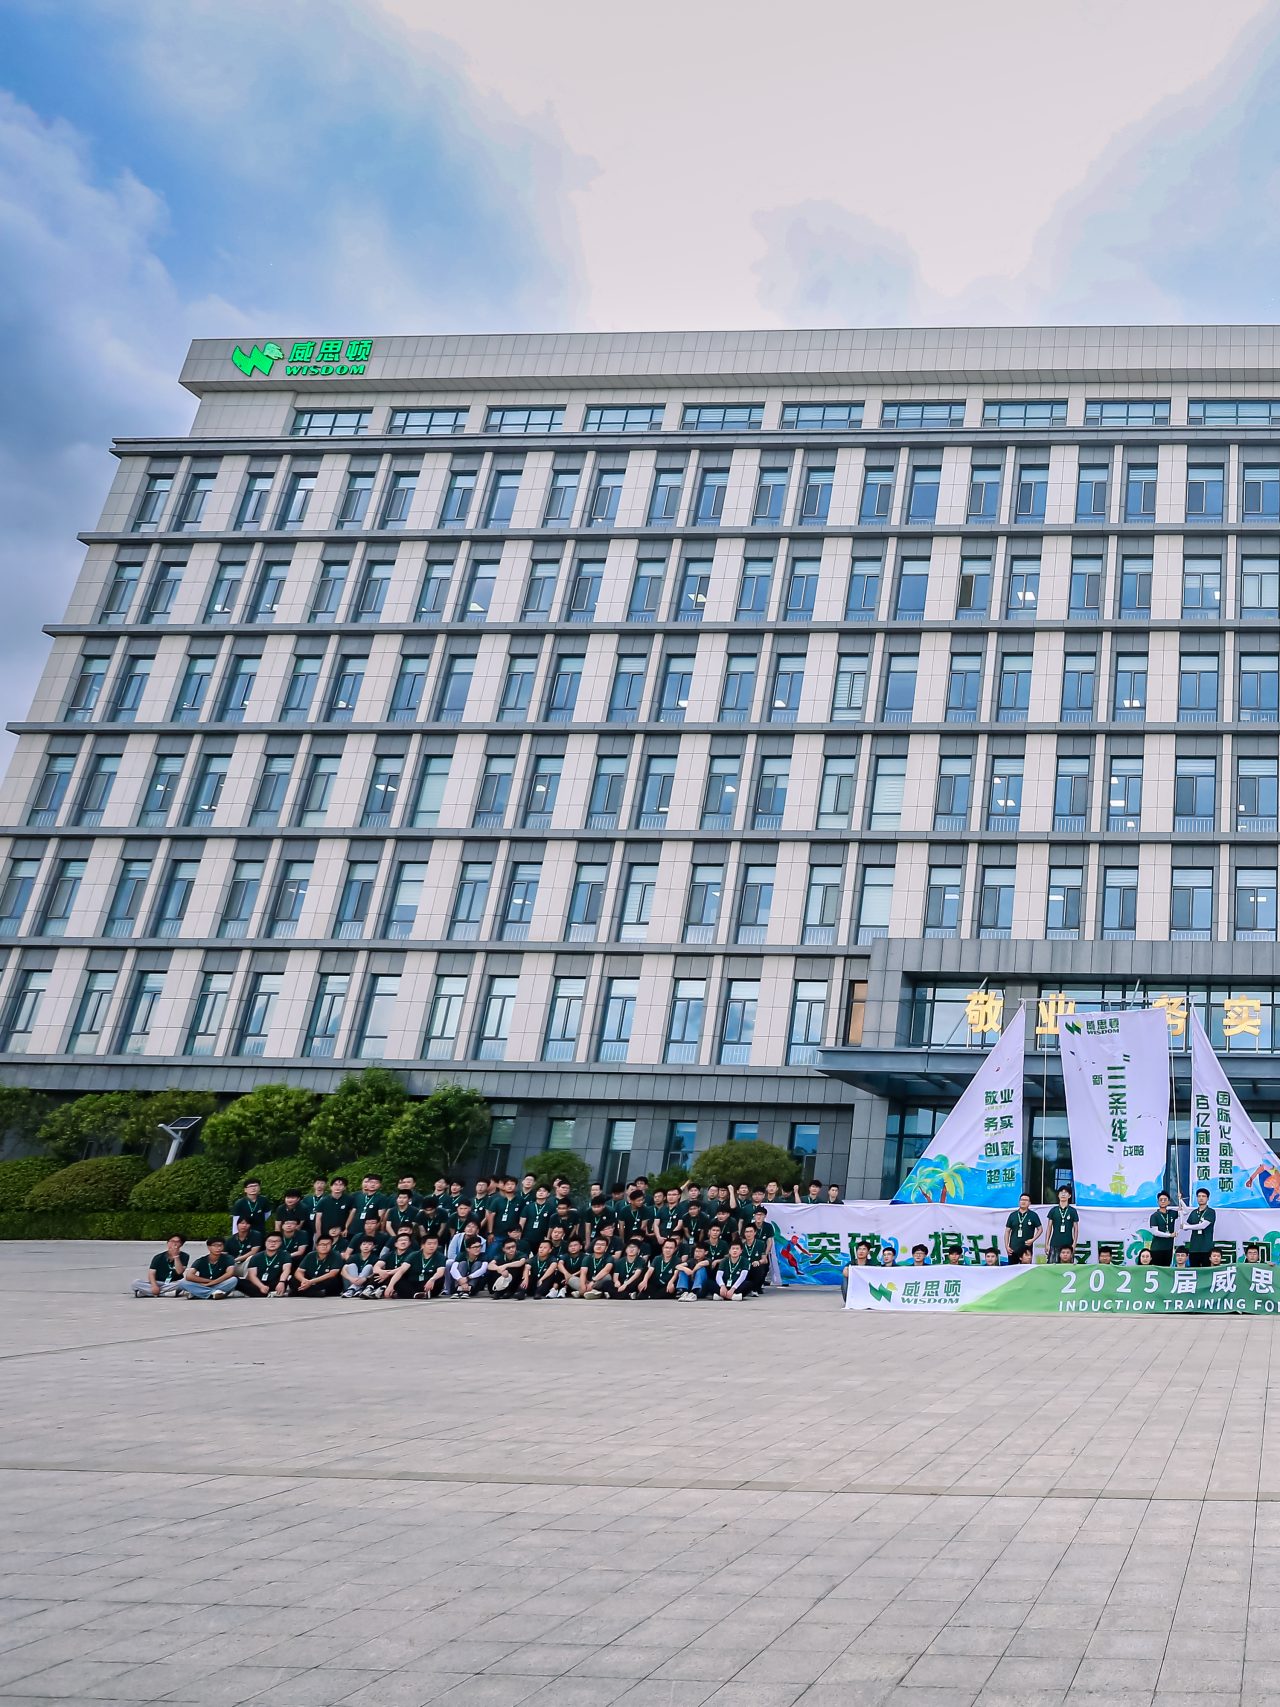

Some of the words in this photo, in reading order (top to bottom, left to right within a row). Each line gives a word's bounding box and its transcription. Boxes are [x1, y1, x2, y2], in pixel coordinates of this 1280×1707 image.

[288, 339, 373, 362] 威思顿
[285, 364, 365, 376] WISDOM
[1092, 1074, 1103, 1085] 新
[984, 1089, 1014, 1105] 敬业
[984, 1115, 1014, 1132] 务实
[1196, 1094, 1210, 1180] 百亿威思顿
[1216, 1090, 1233, 1192] 国际化威思顿
[984, 1140, 1014, 1157] 创新
[1123, 1145, 1144, 1156] 战略
[986, 1167, 1015, 1184] 超越
[902, 1279, 961, 1297] 威思顿
[1058, 1300, 1155, 1312] INDUCTION
[1163, 1298, 1246, 1311] TRAINING
